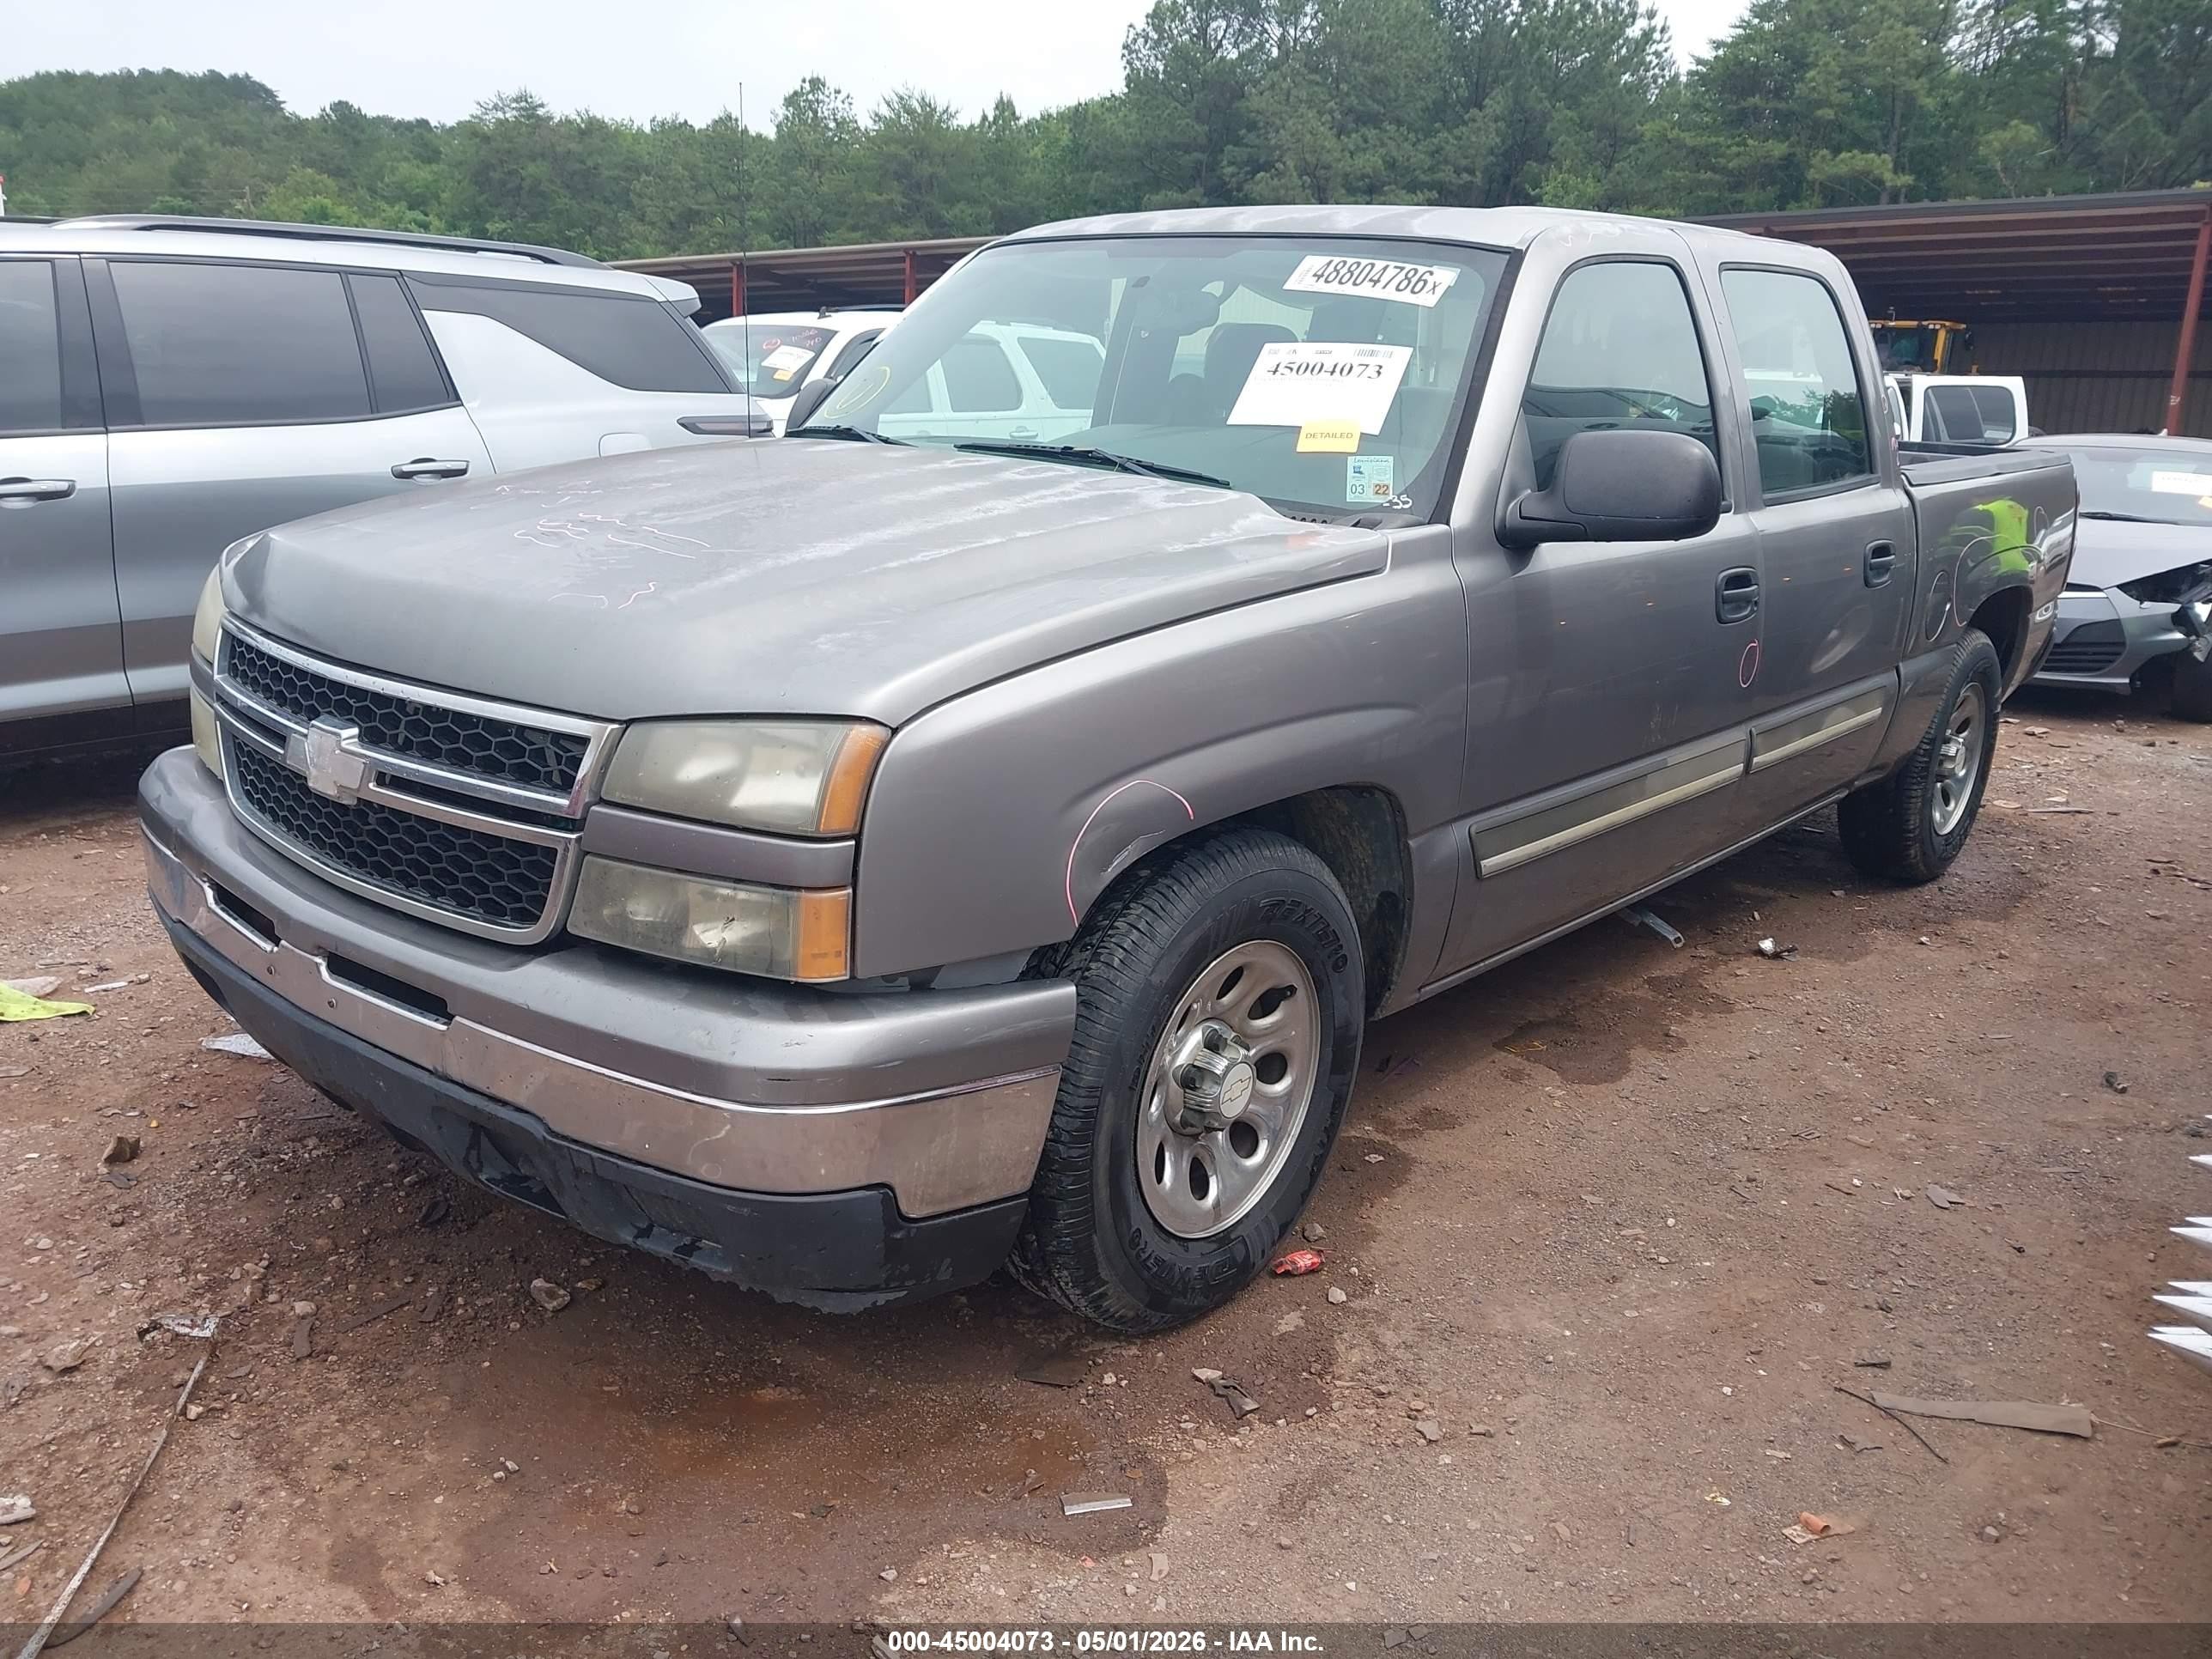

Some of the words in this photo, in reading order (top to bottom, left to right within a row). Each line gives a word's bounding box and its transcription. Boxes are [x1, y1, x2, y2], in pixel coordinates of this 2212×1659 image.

[1267, 361, 1383, 380] 45004073
[1305, 431, 1353, 440] DETAILED
[1350, 483, 1365, 495] 03
[1374, 483, 1389, 495] 22
